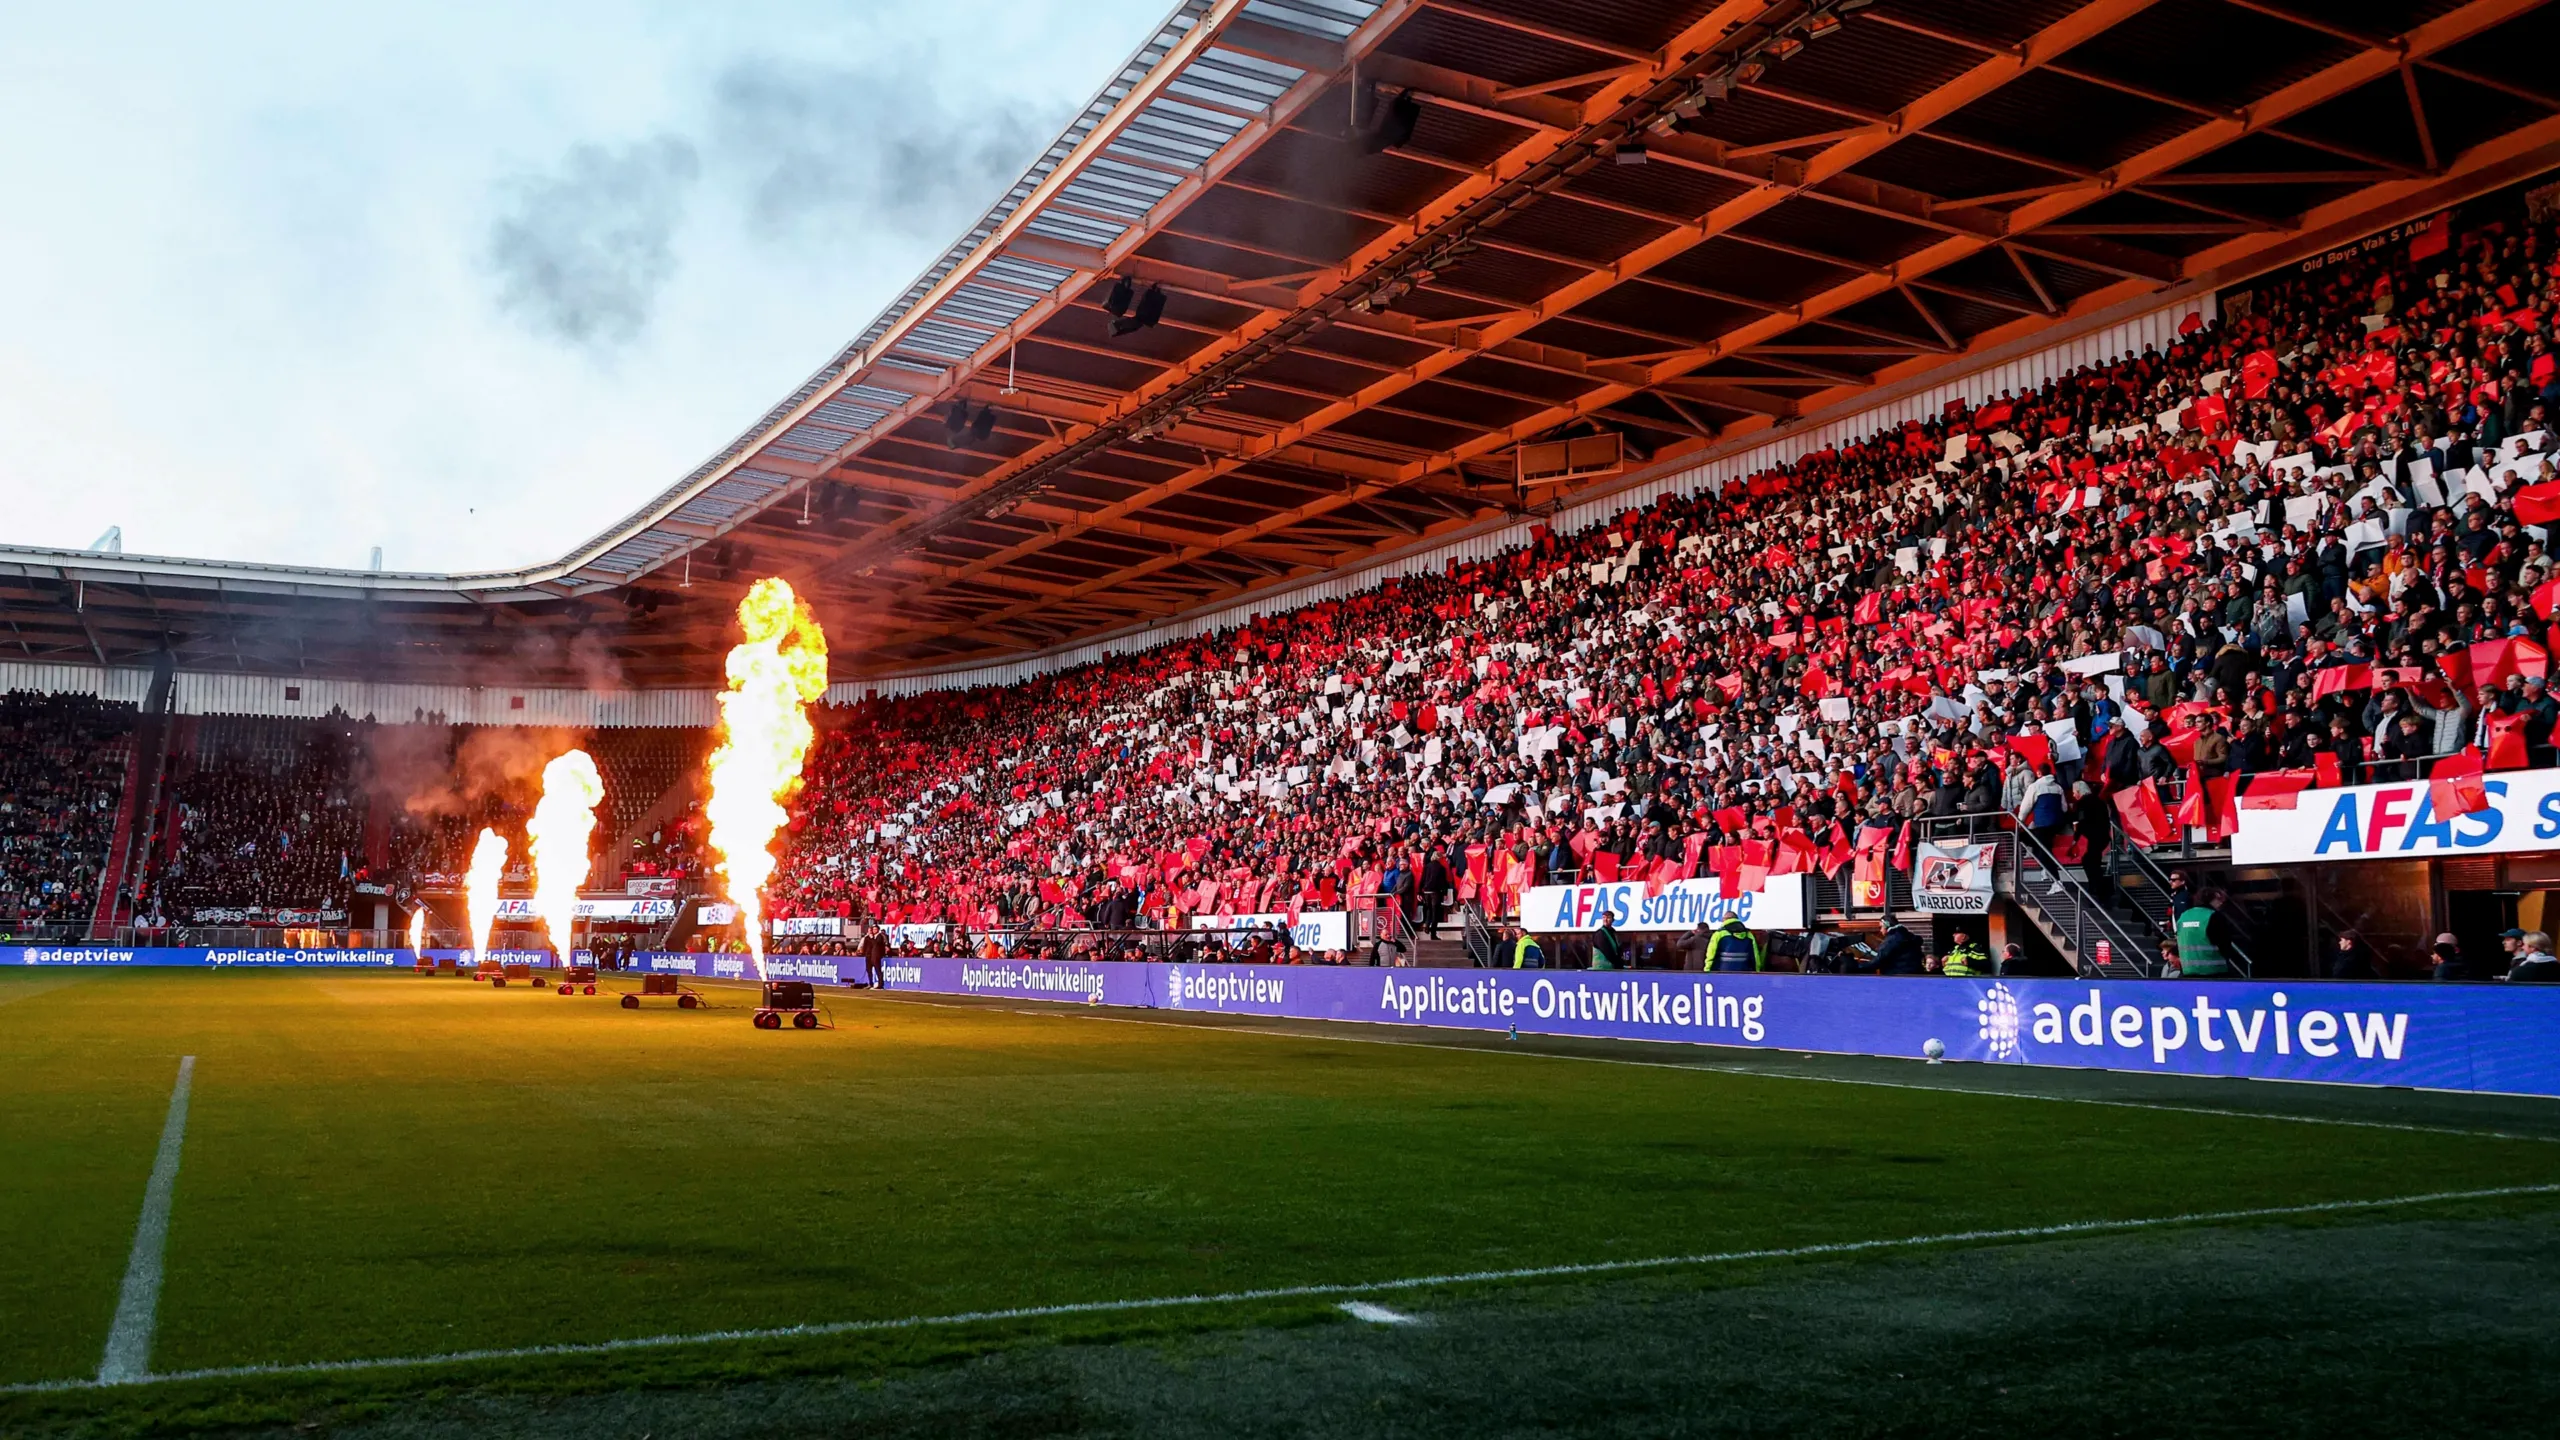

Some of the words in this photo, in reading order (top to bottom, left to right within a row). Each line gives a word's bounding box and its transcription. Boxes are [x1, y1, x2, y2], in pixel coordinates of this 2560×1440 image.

[2302, 257, 2324, 273] Old
[2327, 246, 2358, 265] Boys
[2362, 236, 2386, 252] Vak
[2314, 780, 2508, 855] AFAS
[631, 901, 667, 914] AFAS
[1555, 886, 1631, 928] AFAS
[1918, 895, 1985, 911] WARRIORS
[40, 949, 134, 964] adeptview
[205, 949, 394, 965] Applicatie-Ontwikkeling
[484, 951, 542, 968] deptview
[766, 958, 838, 984] Applicatie-Ontwikkeling
[961, 964, 1104, 1000] Applicatie-Ontwikkeling
[1184, 969, 1284, 1008] adeptview
[1380, 974, 1765, 1043] Applicatie-Ontwikkeling
[2031, 988, 2409, 1064] adeptview
